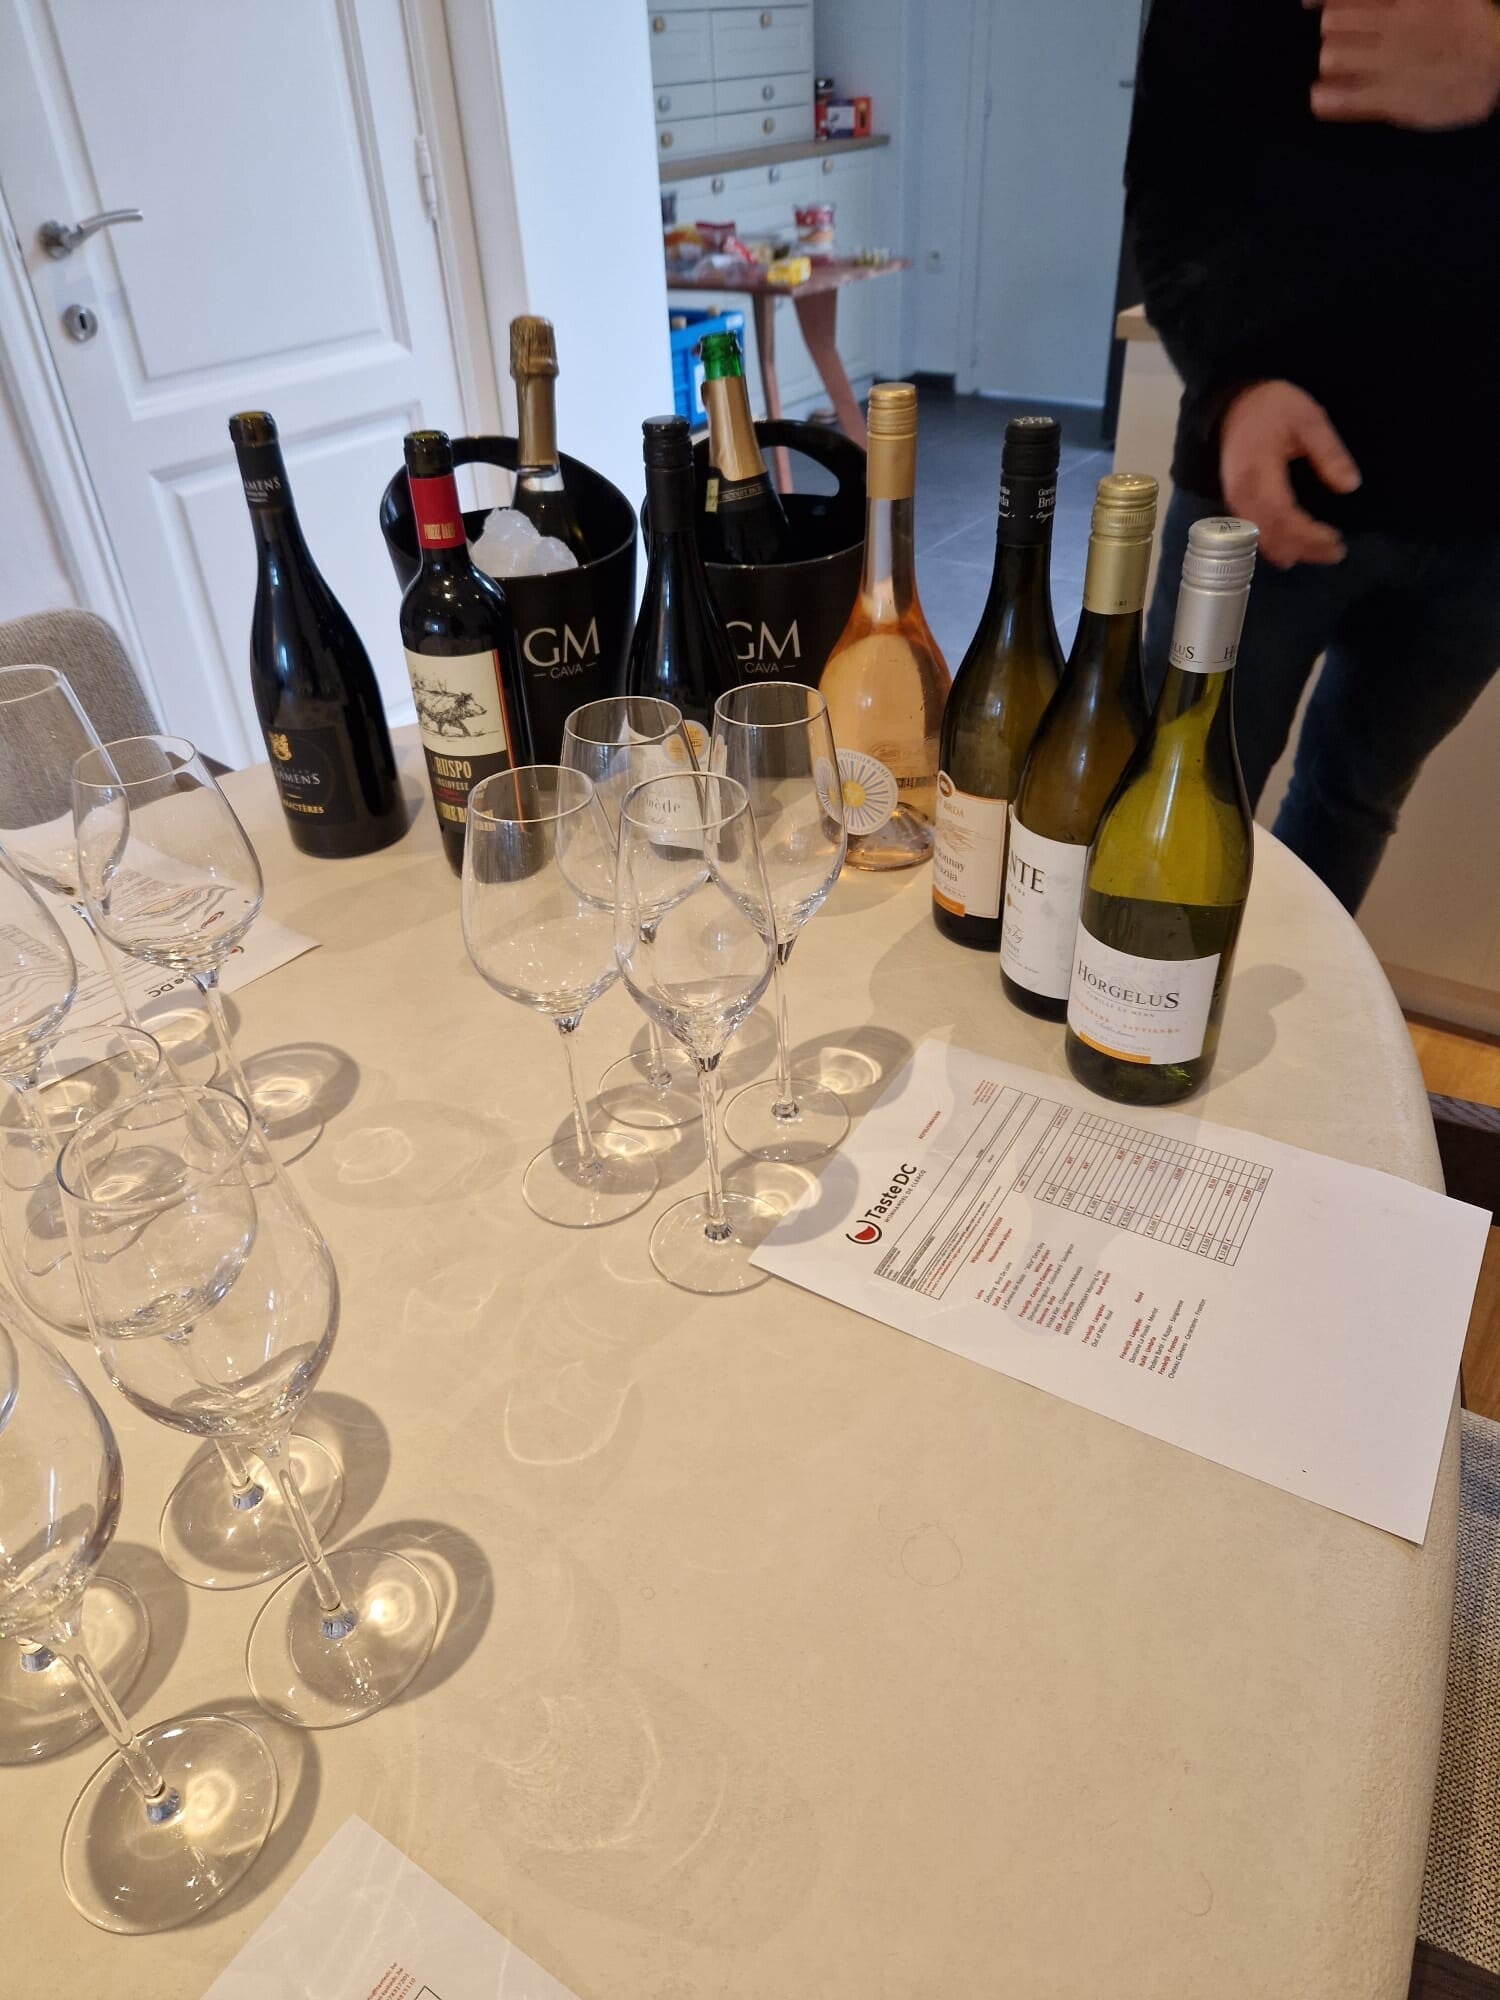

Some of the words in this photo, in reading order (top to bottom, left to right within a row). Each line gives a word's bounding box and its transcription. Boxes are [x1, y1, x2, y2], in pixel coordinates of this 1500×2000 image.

[523, 616, 600, 667] GM
[551, 662, 583, 679] CAVA
[745, 662, 779, 673] CAVA
[434, 757, 472, 779] RUSPO
[1008, 849, 1045, 894] NTE
[1077, 960, 1180, 1009] HORGELUS
